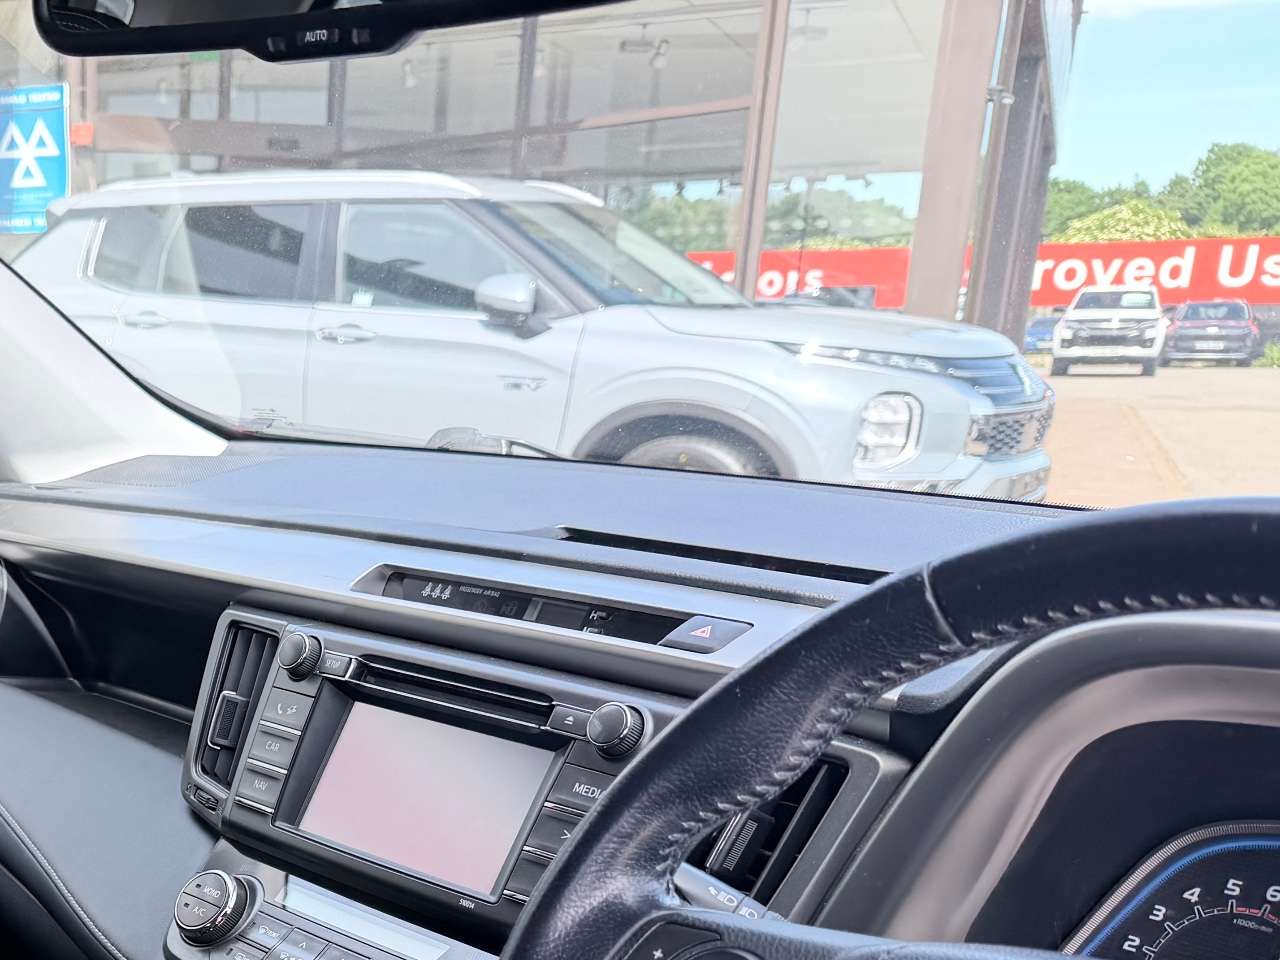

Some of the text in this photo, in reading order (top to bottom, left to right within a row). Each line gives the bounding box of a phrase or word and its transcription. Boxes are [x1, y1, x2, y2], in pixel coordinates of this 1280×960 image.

[304, 29, 327, 42] AUTO
[1031, 244, 1280, 291] roved Us
[265, 741, 280, 752] CAR
[253, 779, 269, 791] NAV
[572, 782, 601, 799] MEDI
[1182, 887, 1202, 903] 4
[1223, 878, 1244, 896] 5
[1265, 885, 1280, 902] 6
[192, 905, 206, 917] A/C
[1148, 904, 1167, 922] 3
[1122, 935, 1141, 953] 2
